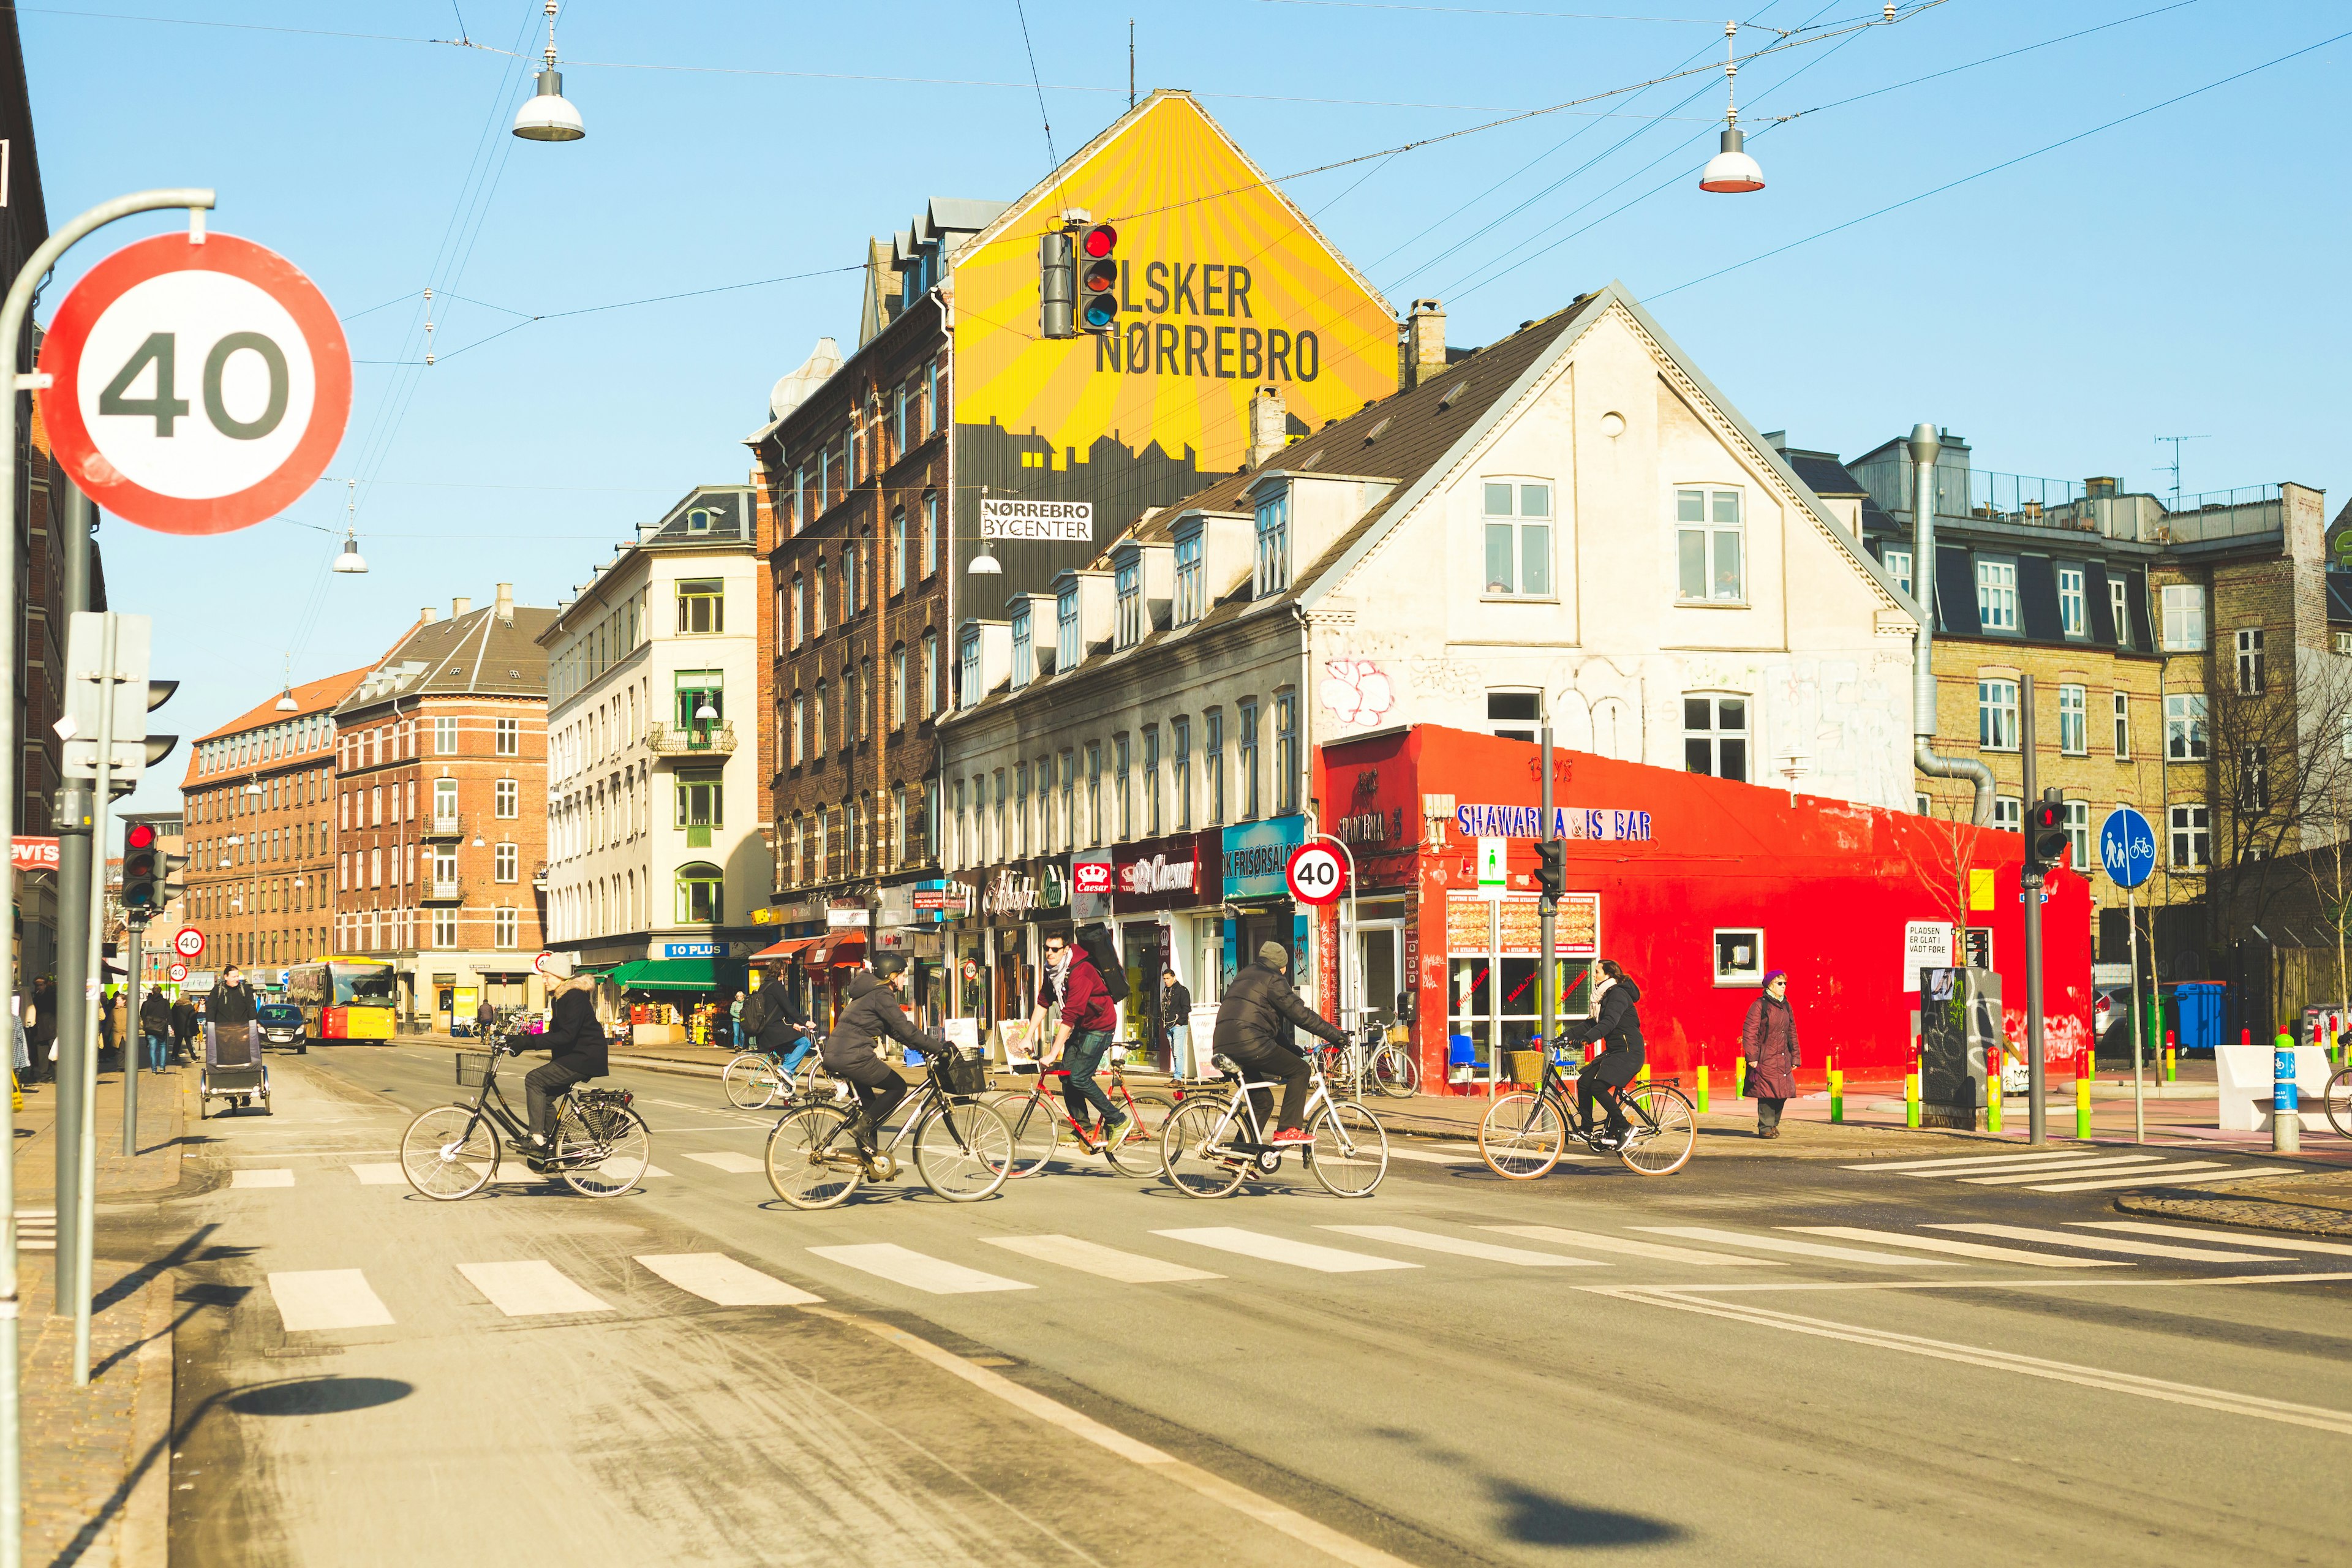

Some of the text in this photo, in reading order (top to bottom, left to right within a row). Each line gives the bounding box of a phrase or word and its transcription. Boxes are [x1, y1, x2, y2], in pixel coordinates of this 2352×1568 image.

[1114, 260, 1253, 318] LSKER
[1096, 321, 1319, 382] NØRREBRO
[99, 331, 289, 440] 40
[984, 502, 1089, 519] NØRREBRO
[984, 519, 1089, 538] BYCENTER
[1457, 805, 1566, 838] SHAWARA
[1586, 809, 1604, 840] IS
[1615, 810, 1652, 842] BAR
[1297, 862, 1334, 885] 40
[1077, 883, 1109, 892] Caesar
[180, 938, 199, 949] 40
[671, 945, 721, 955] 10 PLUS
[1909, 943, 1927, 953] VÅDT
[1470, 967, 1490, 993] KYLLING
[1507, 983, 1526, 1003] HALAL
